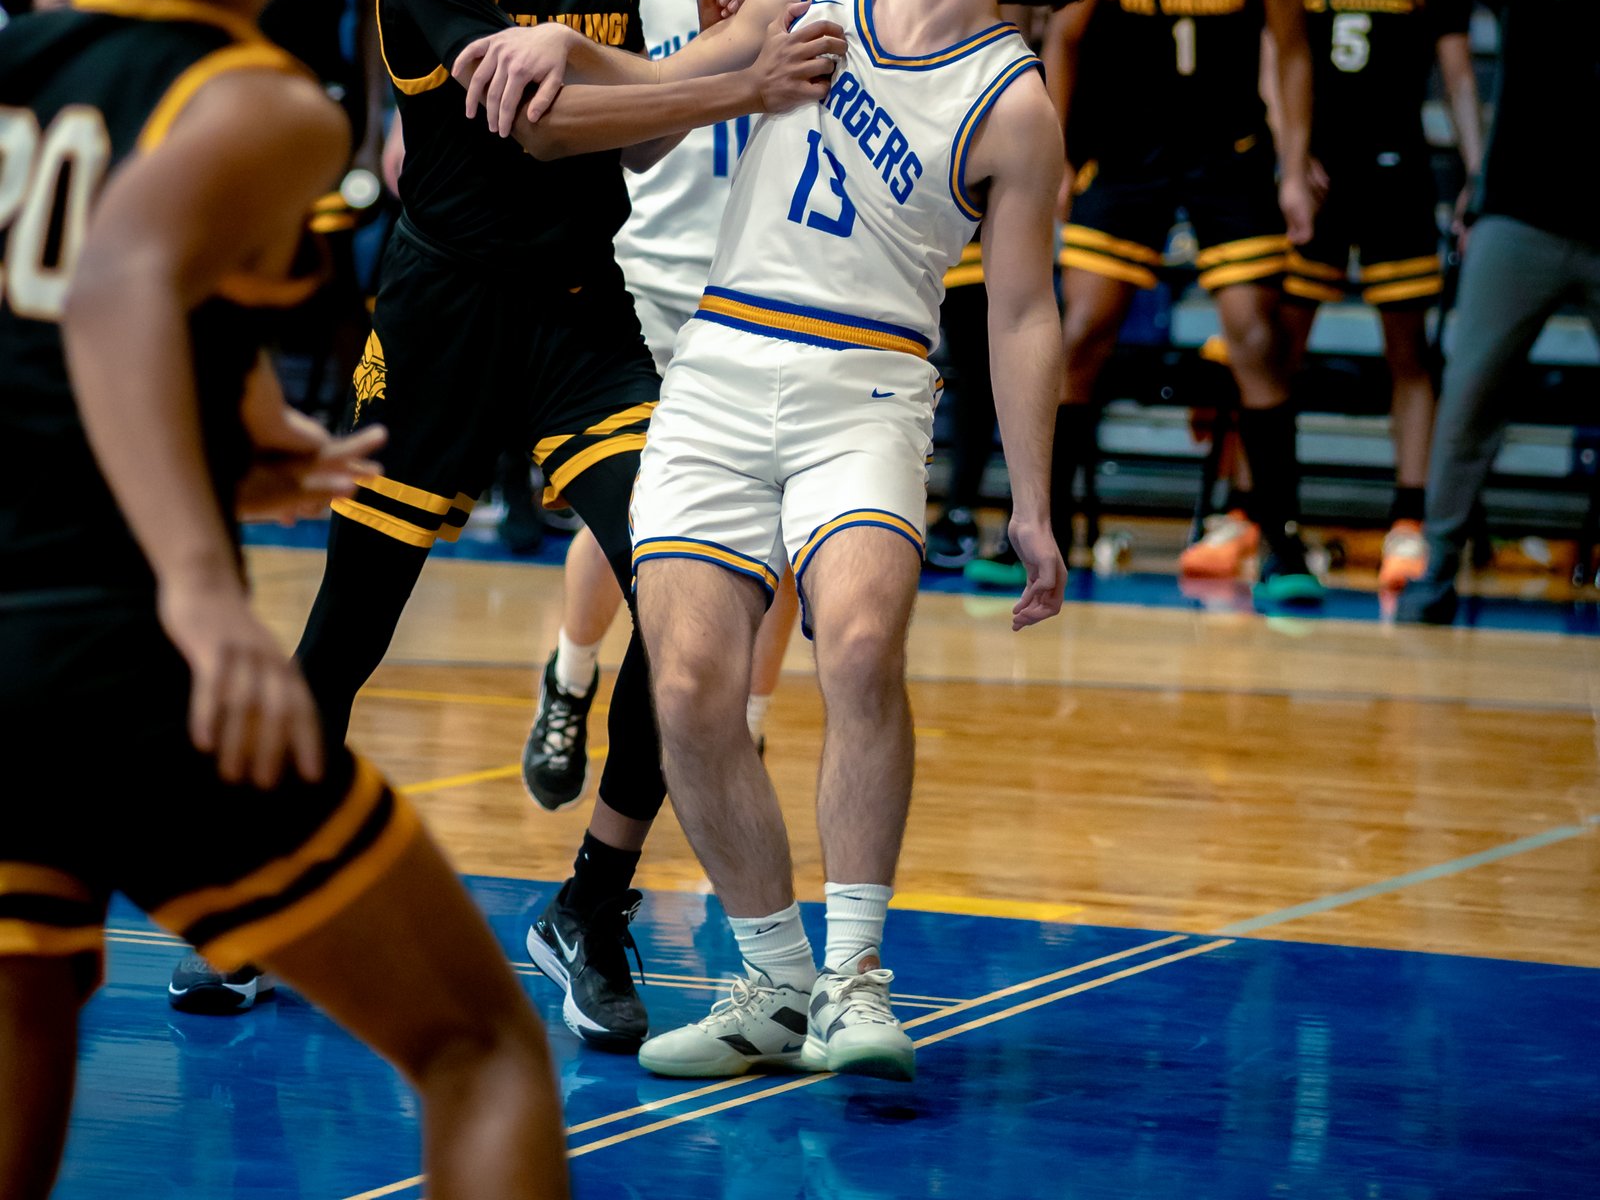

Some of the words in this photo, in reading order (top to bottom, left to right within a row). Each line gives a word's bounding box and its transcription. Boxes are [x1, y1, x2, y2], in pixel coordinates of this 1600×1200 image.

[1172, 17, 1196, 75] 1
[1330, 13, 1372, 73] 5
[820, 71, 923, 206] RGERS
[787, 129, 857, 238] 13
